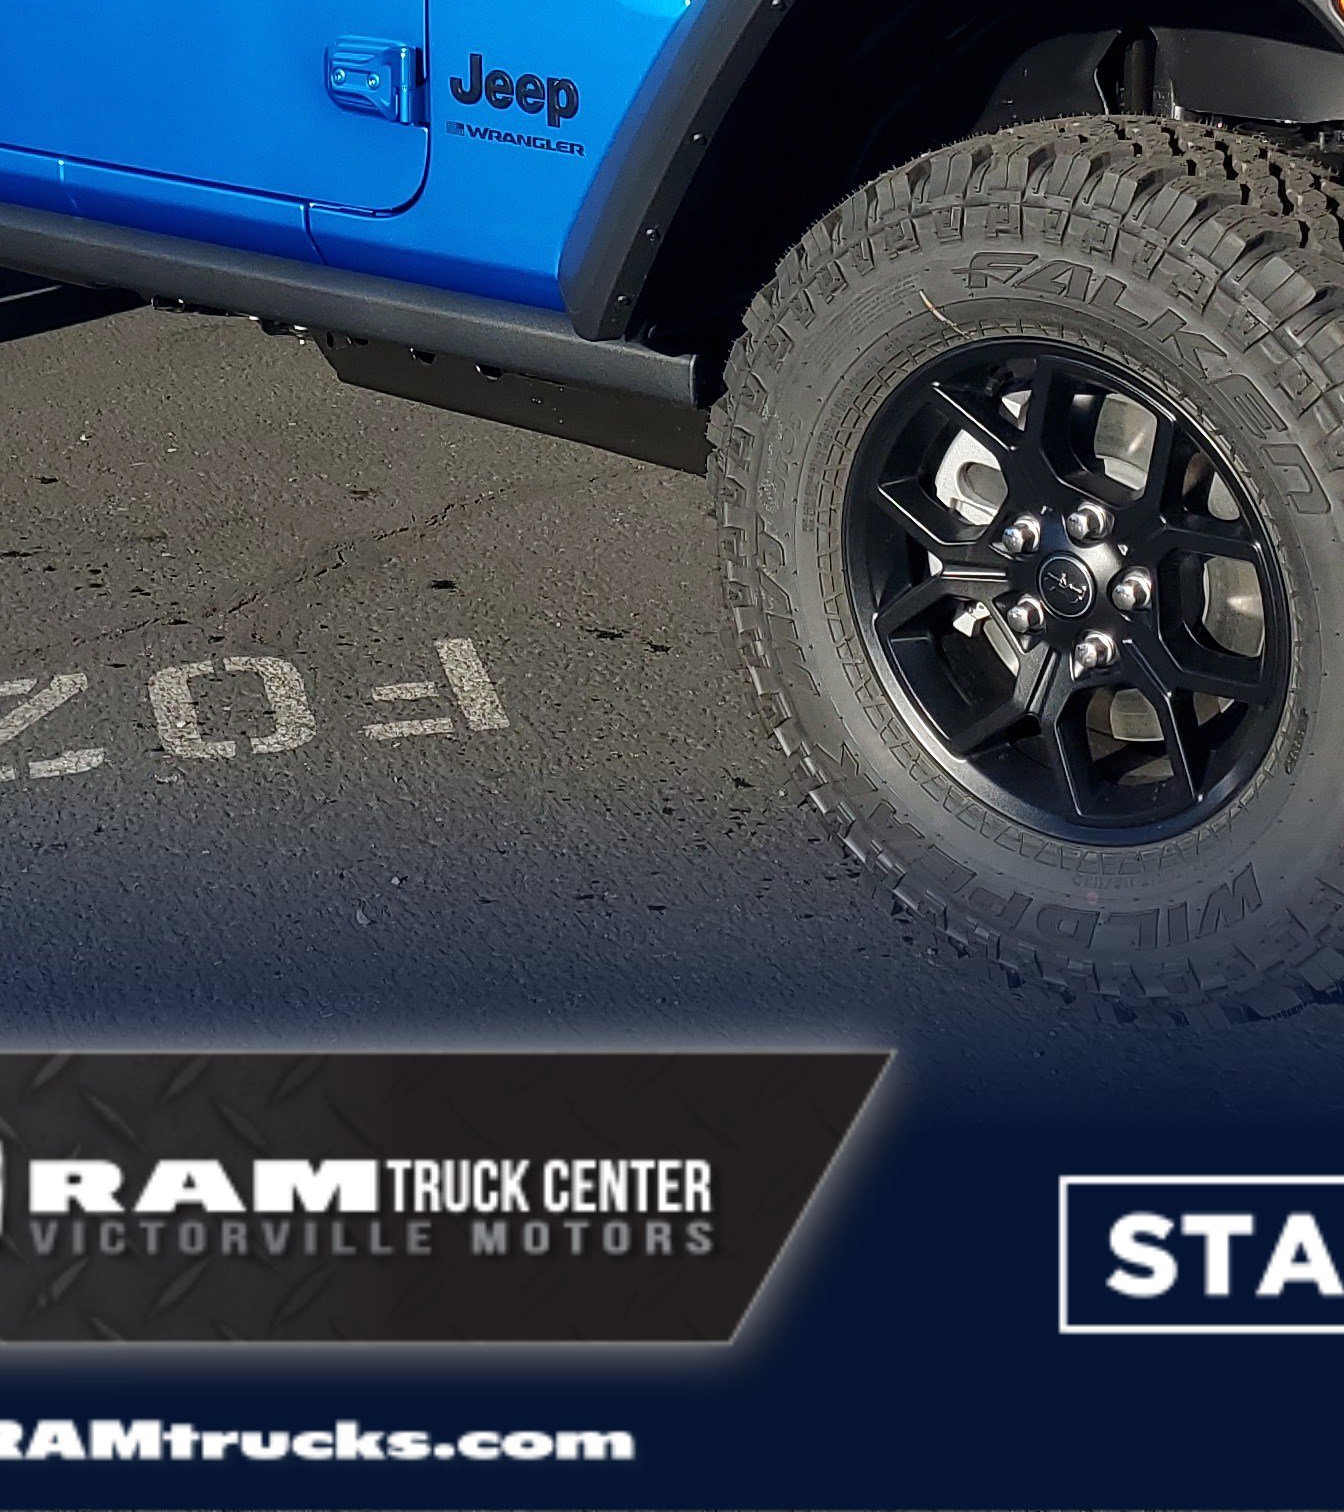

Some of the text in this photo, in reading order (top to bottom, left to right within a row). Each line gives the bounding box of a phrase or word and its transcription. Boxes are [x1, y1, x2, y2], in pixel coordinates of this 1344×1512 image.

[449, 53, 579, 129] Jeep
[466, 123, 586, 157] WRANGLER
[950, 251, 1332, 515] FALKEN
